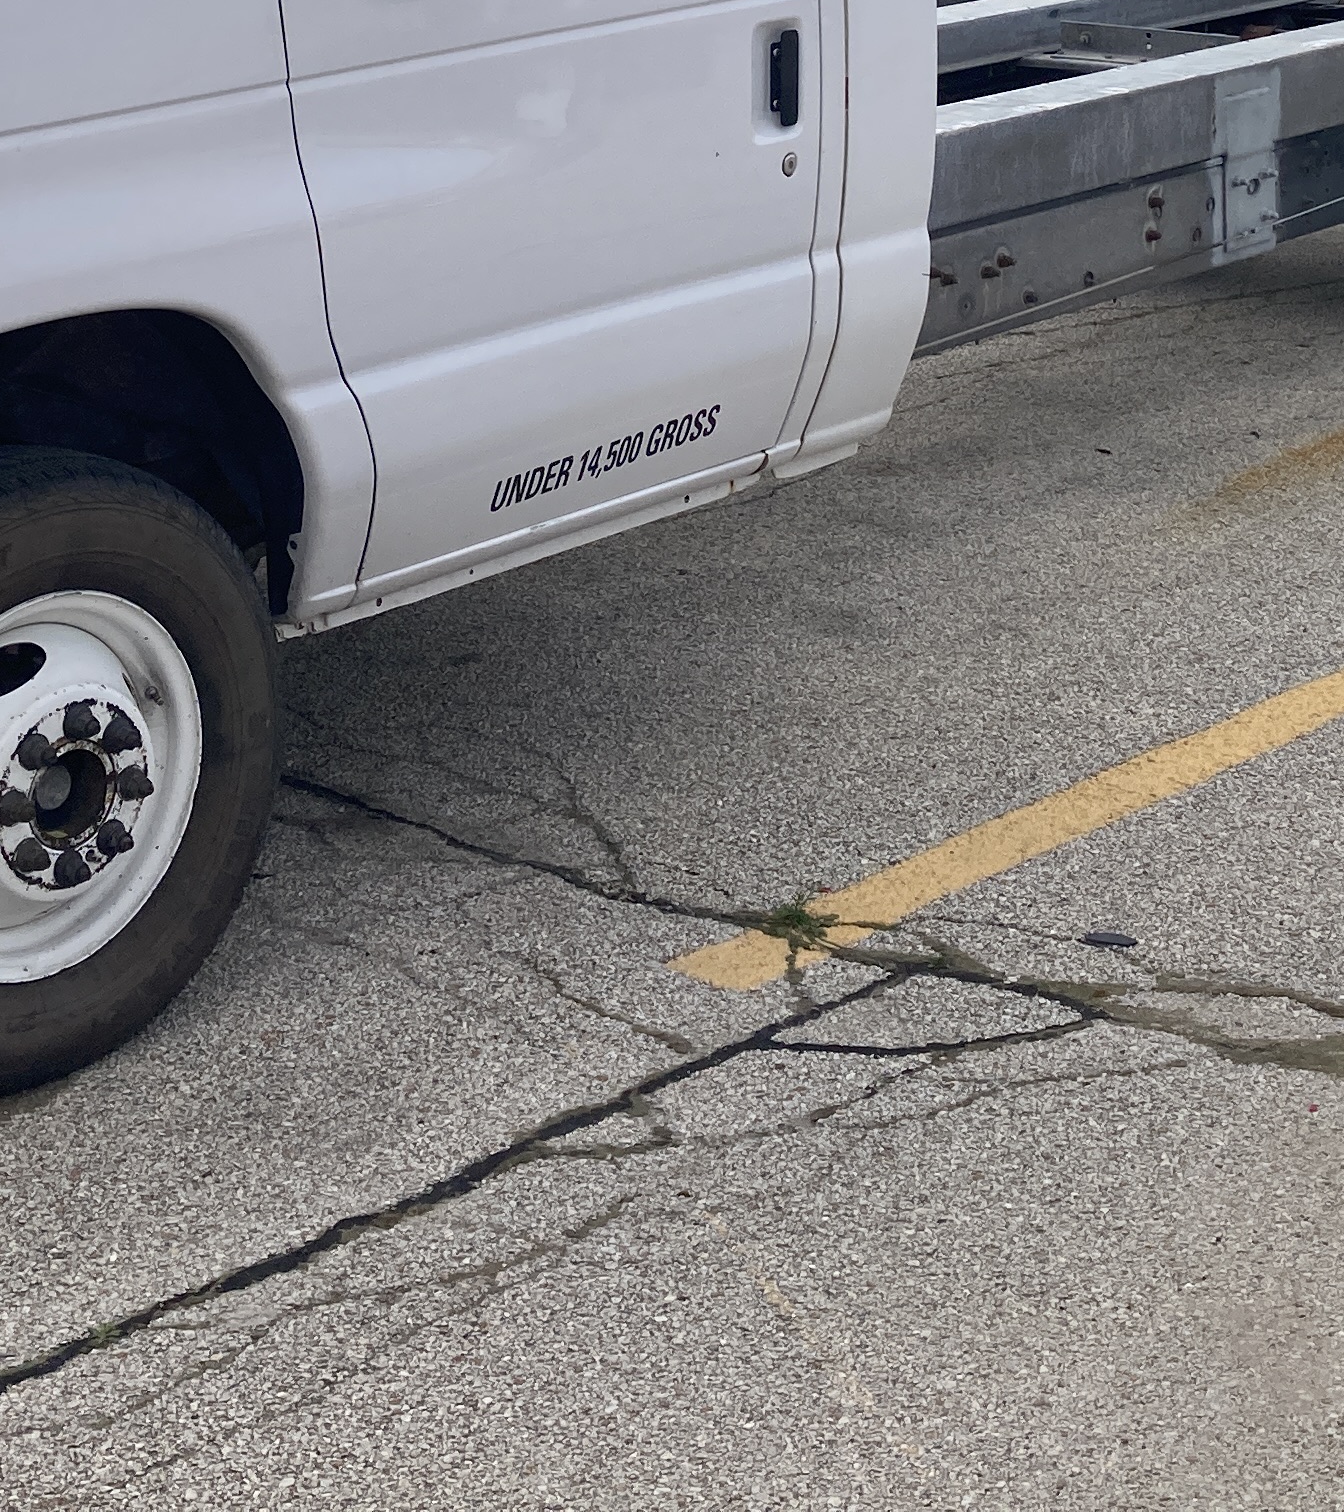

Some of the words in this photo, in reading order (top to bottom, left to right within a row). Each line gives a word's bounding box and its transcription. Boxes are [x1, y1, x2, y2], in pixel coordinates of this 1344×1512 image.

[490, 454, 574, 513] UNDER
[577, 430, 644, 482] 14,500
[645, 404, 721, 457] GROSS
